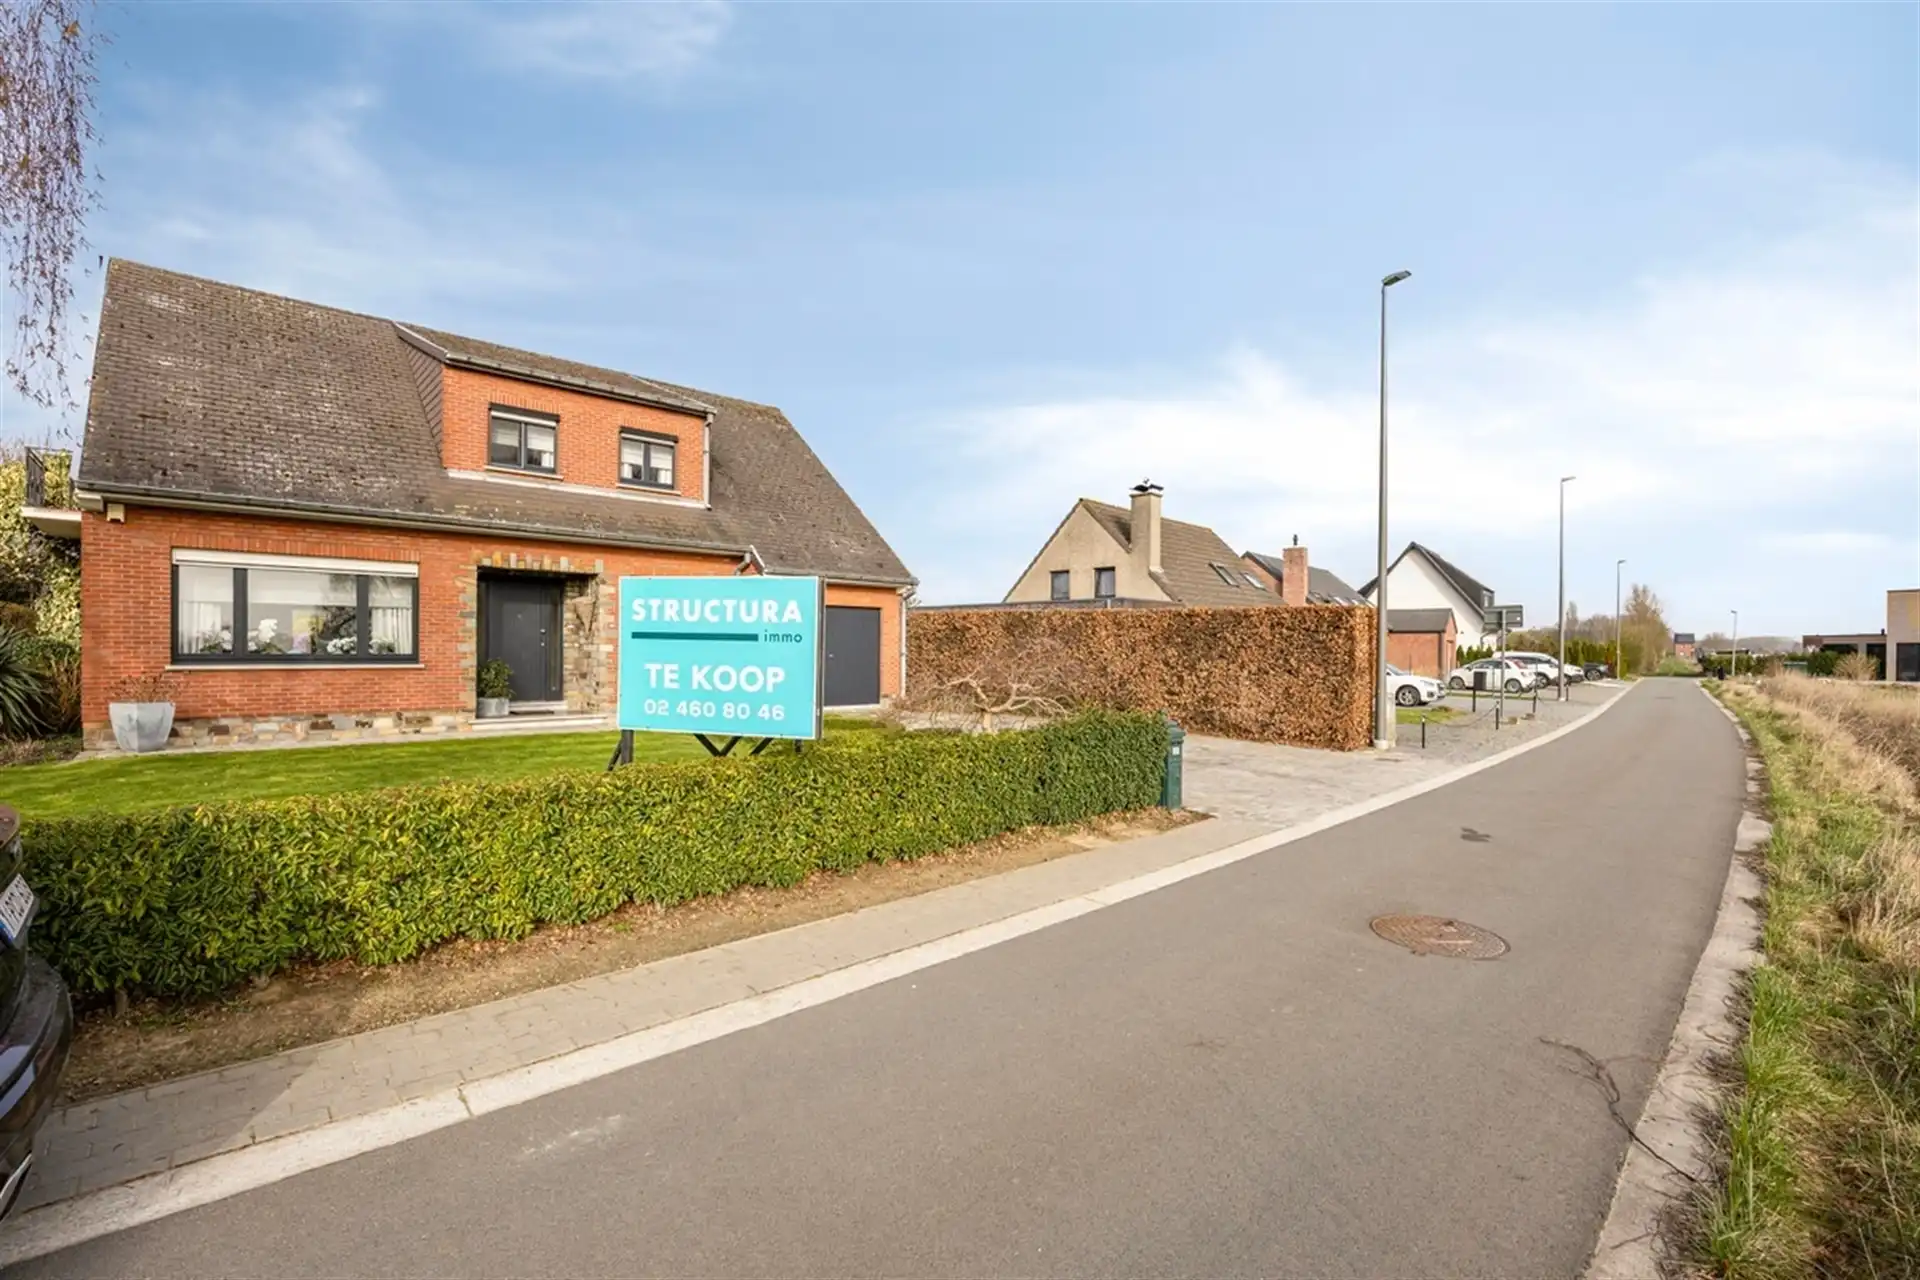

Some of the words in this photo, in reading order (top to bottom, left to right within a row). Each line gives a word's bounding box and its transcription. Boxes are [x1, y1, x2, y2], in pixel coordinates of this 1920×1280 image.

[631, 598, 803, 623] STRUCTURA
[764, 629, 803, 643] immo
[643, 663, 680, 689] TE
[691, 664, 786, 693] KOOP
[643, 699, 669, 716] 02
[676, 700, 716, 717] 460
[722, 702, 750, 719] 80
[757, 704, 785, 721] 46
